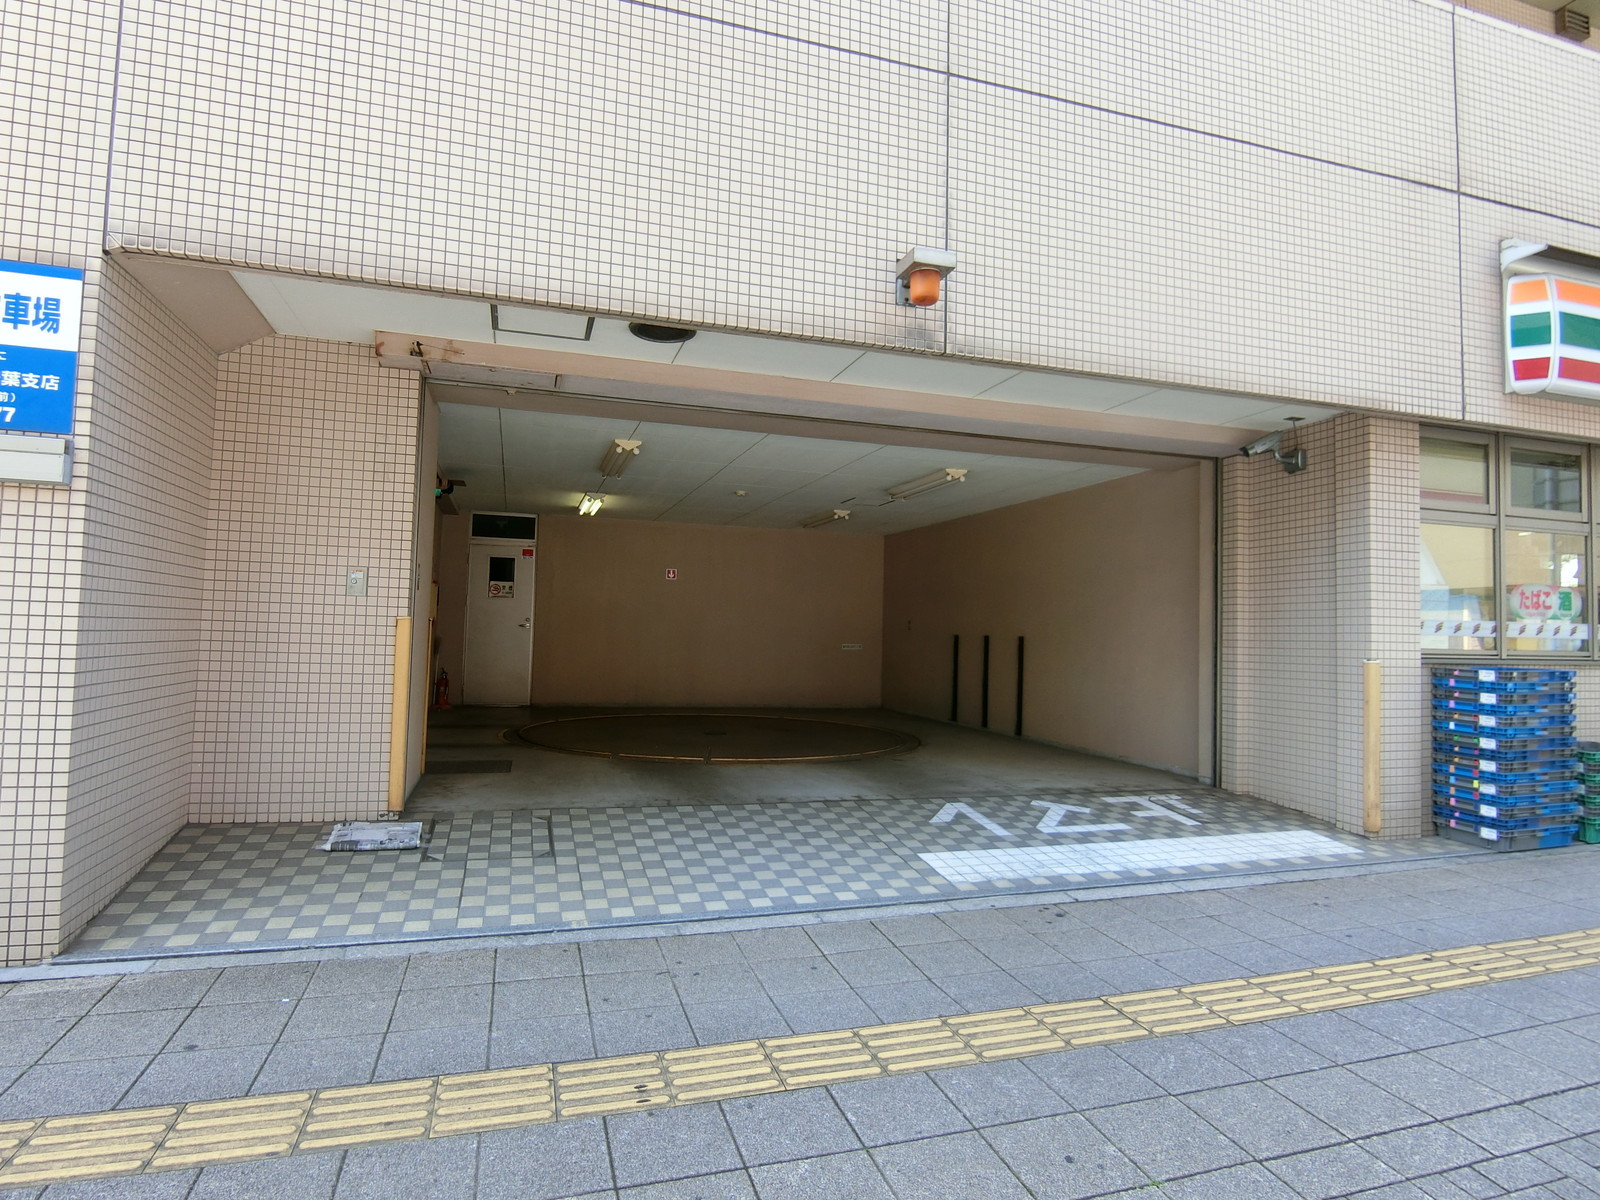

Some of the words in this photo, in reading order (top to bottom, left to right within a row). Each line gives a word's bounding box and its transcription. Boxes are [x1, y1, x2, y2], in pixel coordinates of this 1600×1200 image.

[0, 292, 61, 334] 車場
[0, 370, 60, 391] 葉支店
[0, 406, 16, 423] 7
[1519, 589, 1552, 610] たばこ
